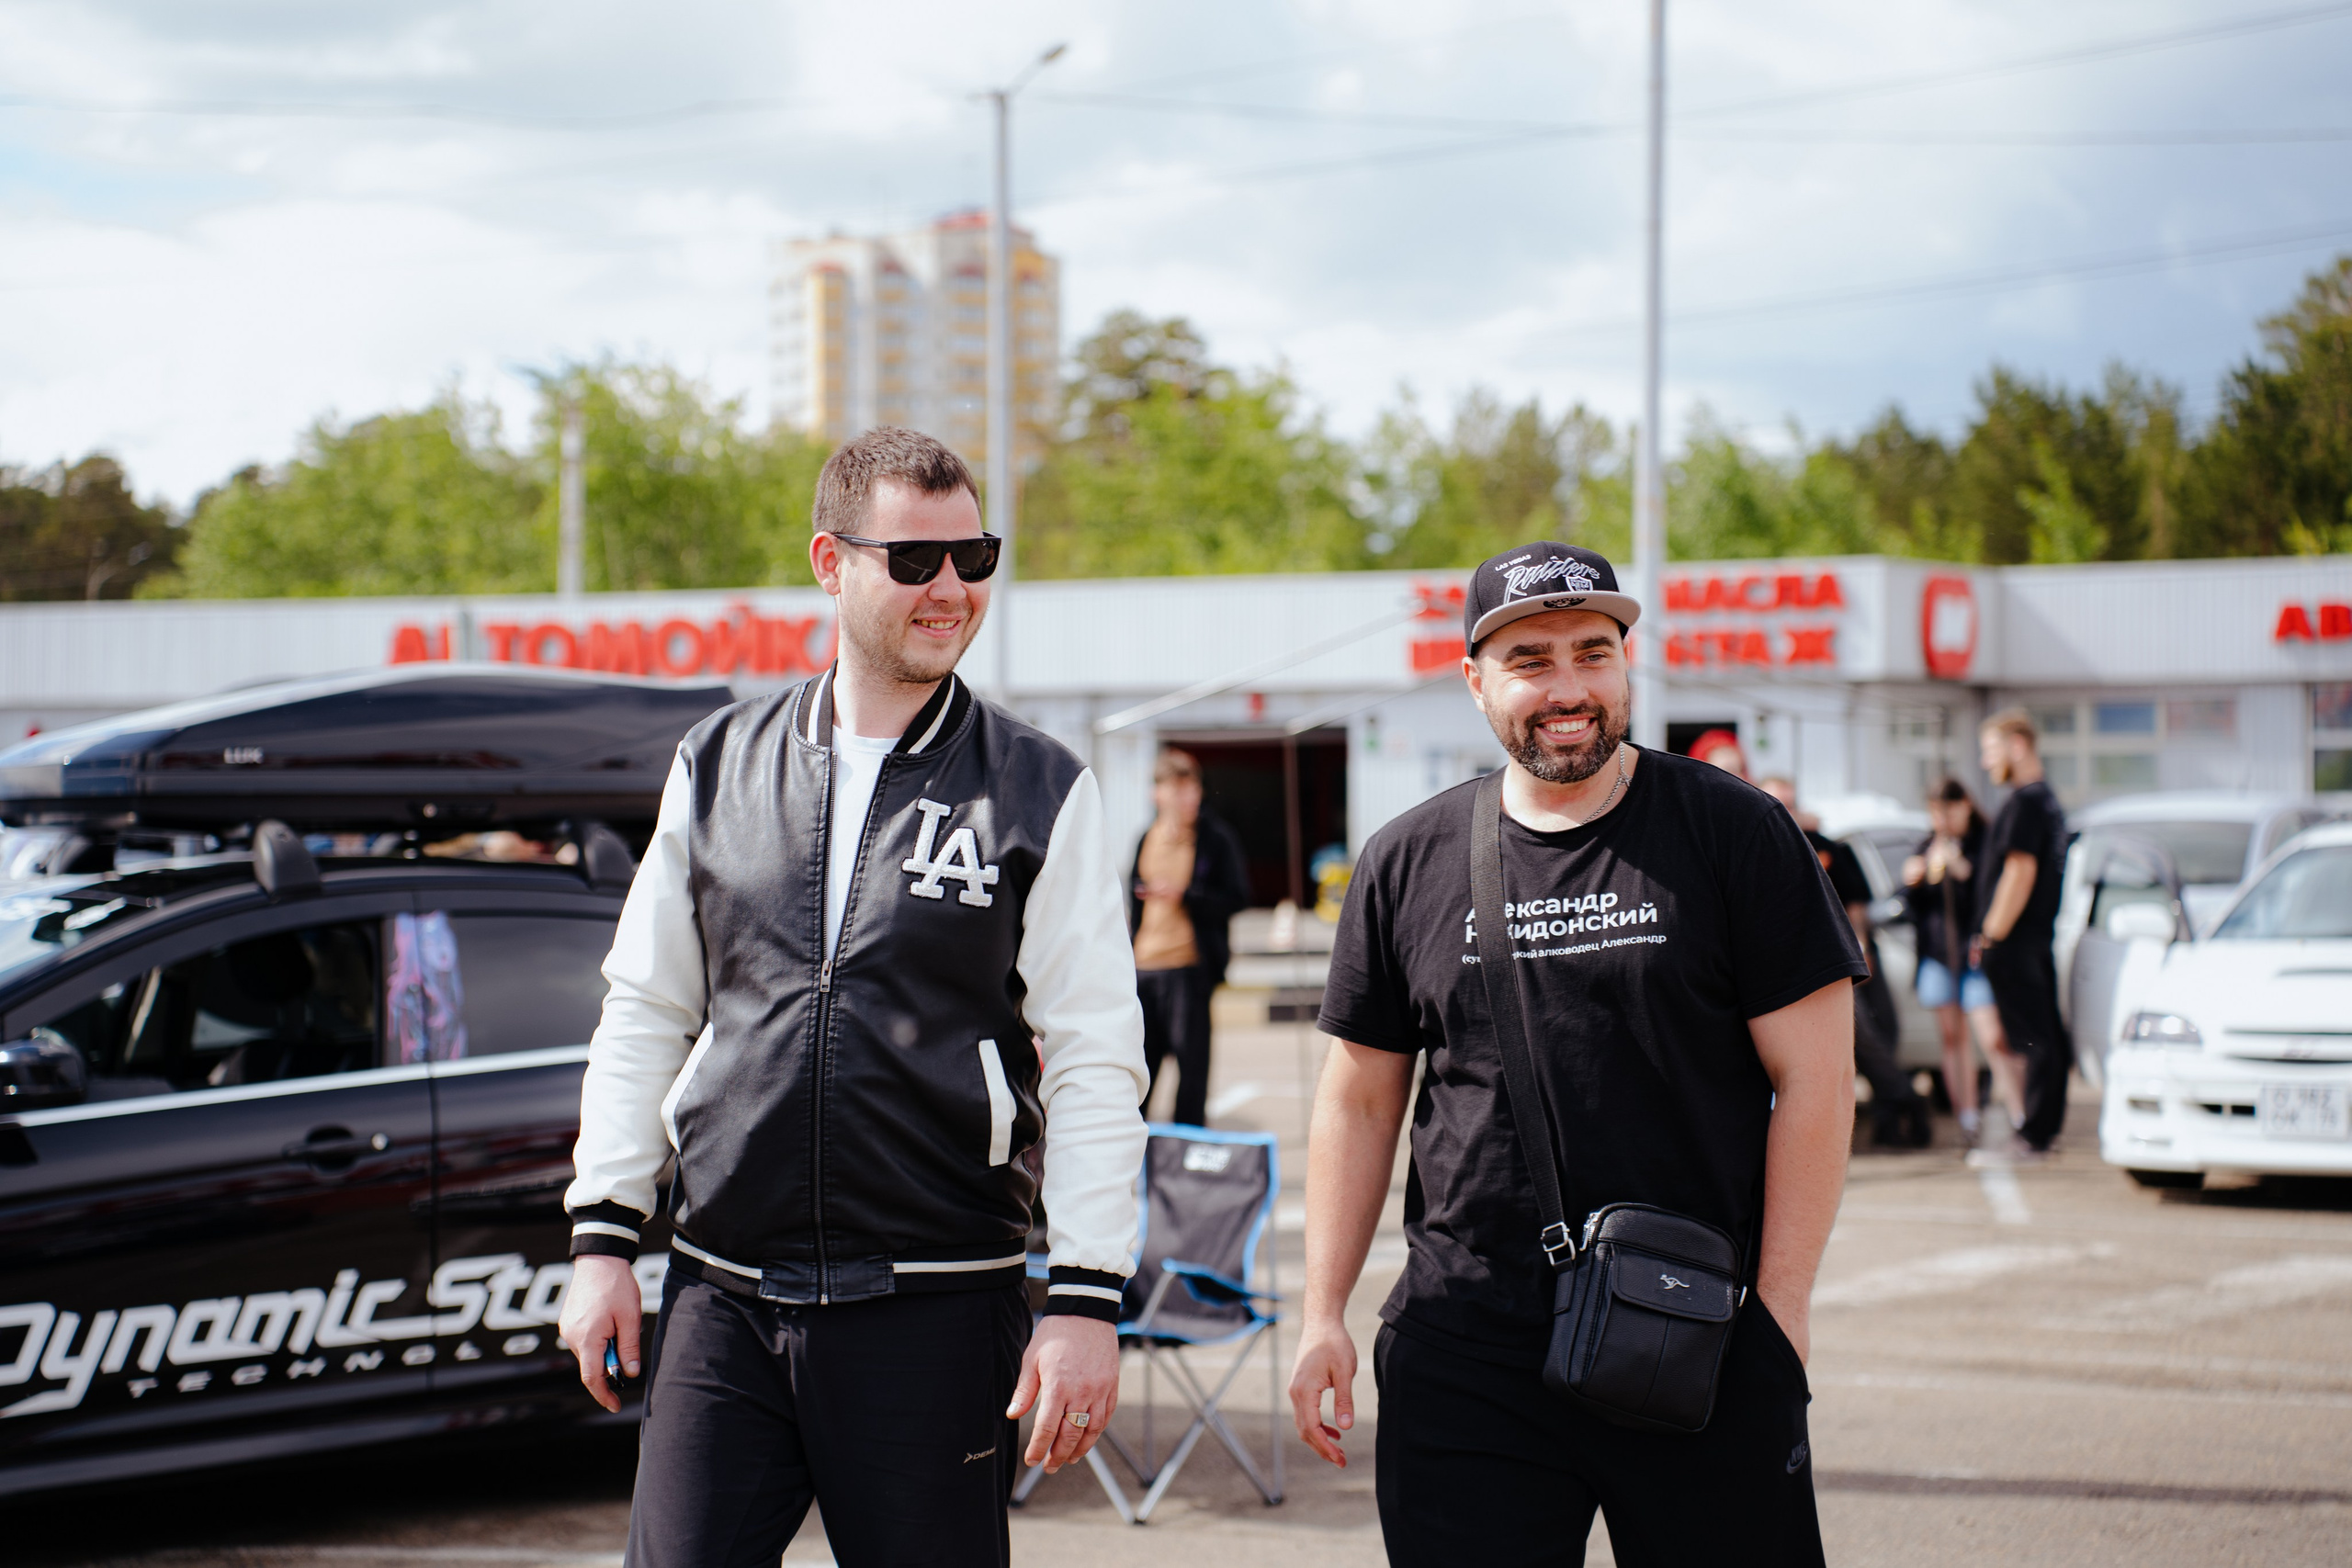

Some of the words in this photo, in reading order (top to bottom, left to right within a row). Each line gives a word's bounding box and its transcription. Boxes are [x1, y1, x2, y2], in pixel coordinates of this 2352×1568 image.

[1495, 562, 1509, 571] LAS
[1503, 556, 1600, 605] Raiders
[390, 595, 838, 677] АТОМОЙК
[223, 747, 264, 764] LUX
[901, 797, 1000, 908] LA
[1464, 902, 1658, 943] Нидонский
[1600, 933, 1668, 950] Александр
[127, 1332, 573, 1398] TECHNOLO
